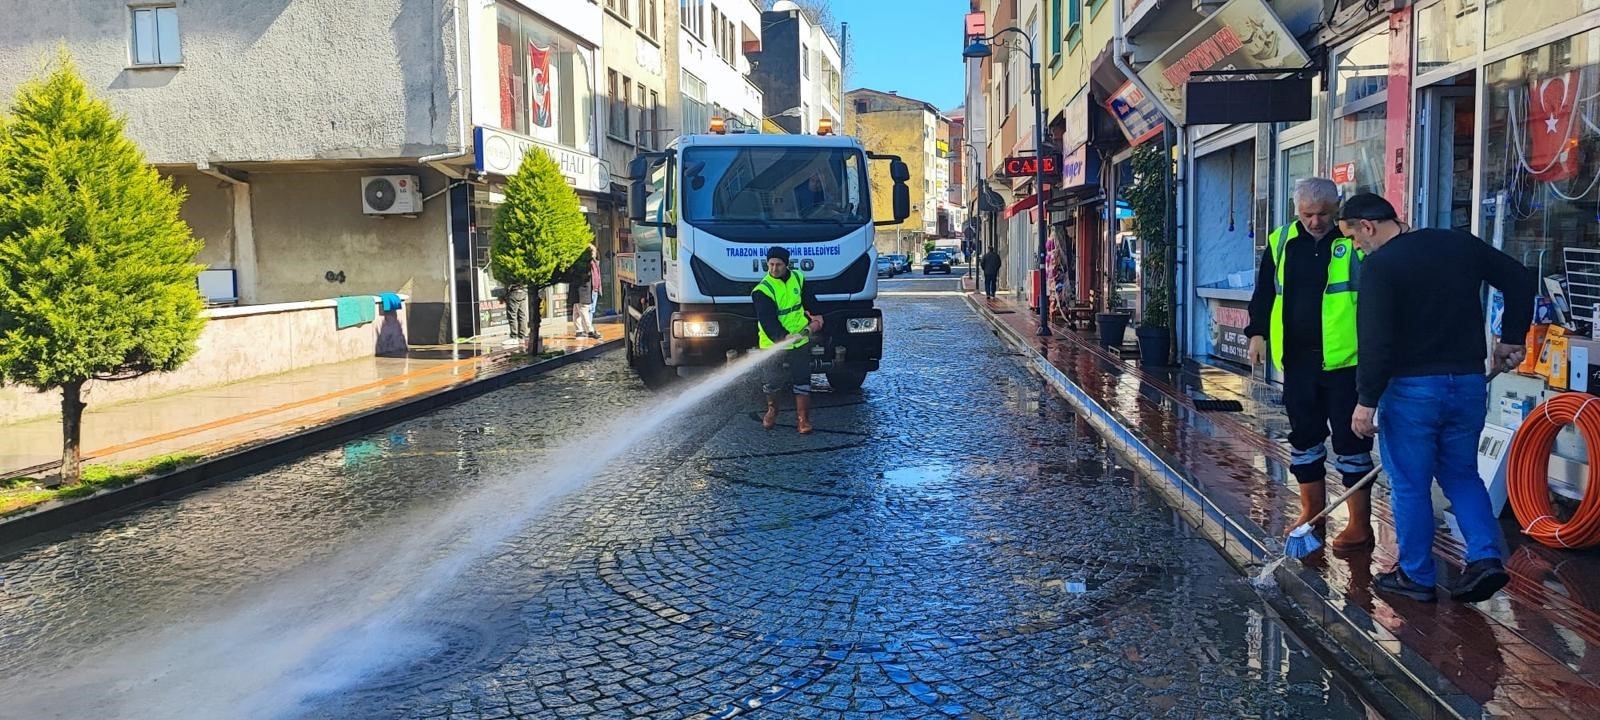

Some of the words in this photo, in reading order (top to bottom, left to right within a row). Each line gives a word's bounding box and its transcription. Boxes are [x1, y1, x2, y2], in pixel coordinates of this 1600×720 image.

[726, 247, 758, 257] TRABZON
[759, 245, 802, 257] BÜEHİR
[803, 243, 841, 256] BELEDİYESİ
[752, 258, 815, 273] IVCO
